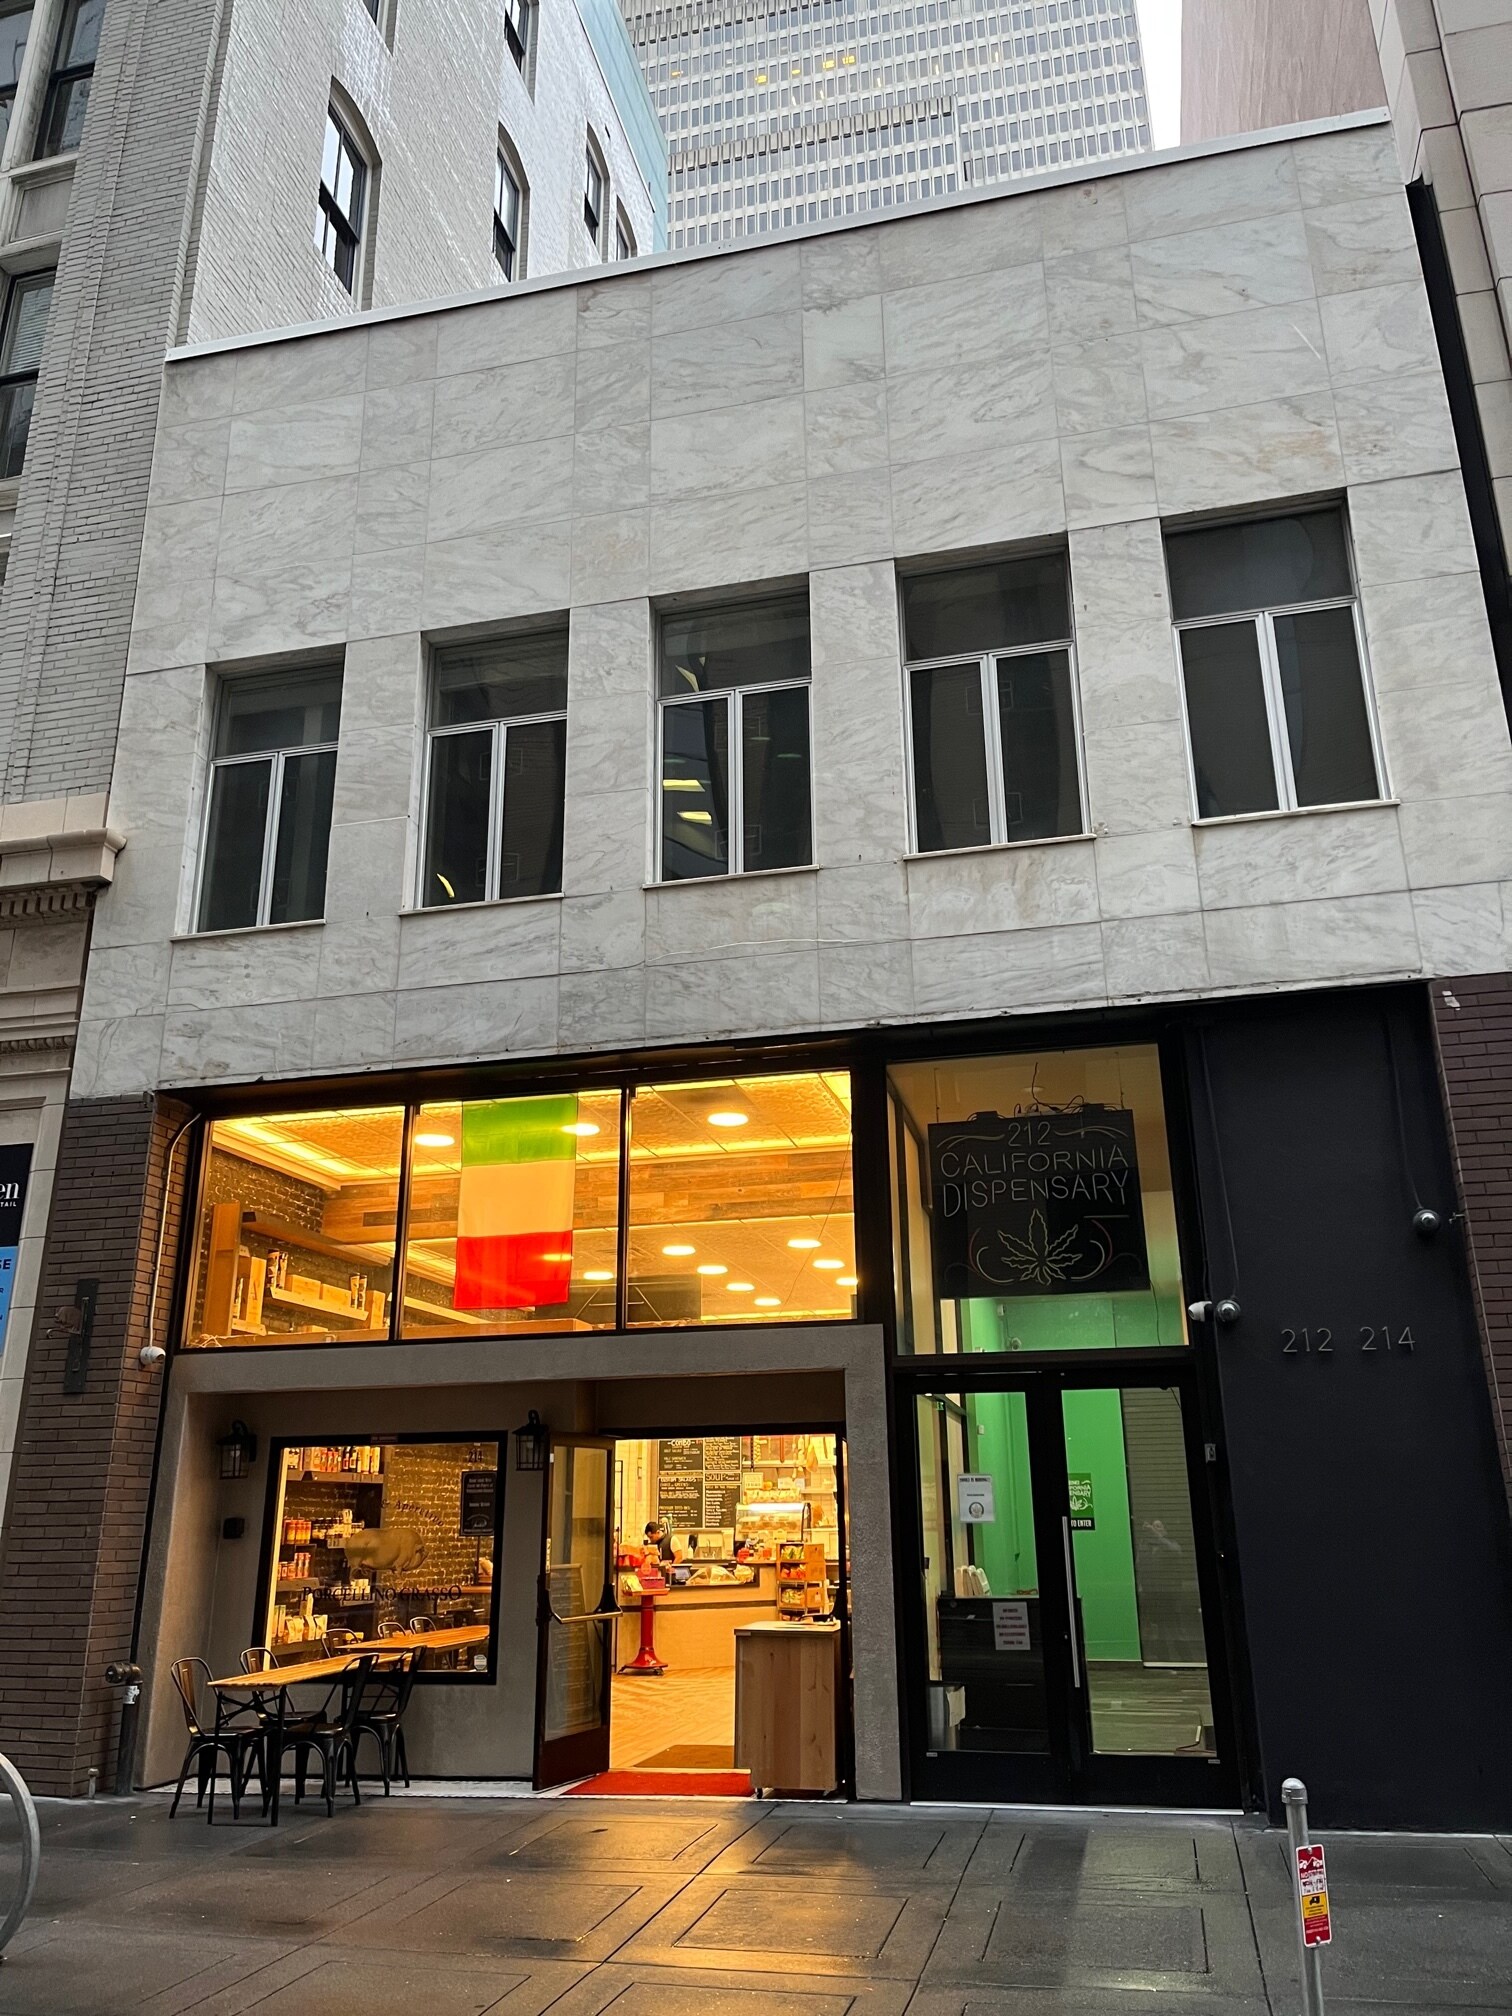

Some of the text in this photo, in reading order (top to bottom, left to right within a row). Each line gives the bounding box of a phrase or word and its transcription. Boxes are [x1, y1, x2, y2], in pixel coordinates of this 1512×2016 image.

[1008, 1121, 1051, 1147] 212
[940, 1144, 1129, 1178] CALIFORNIA
[943, 1170, 1129, 1218] DISPENSARY
[1281, 1326, 1416, 1353] 212 214
